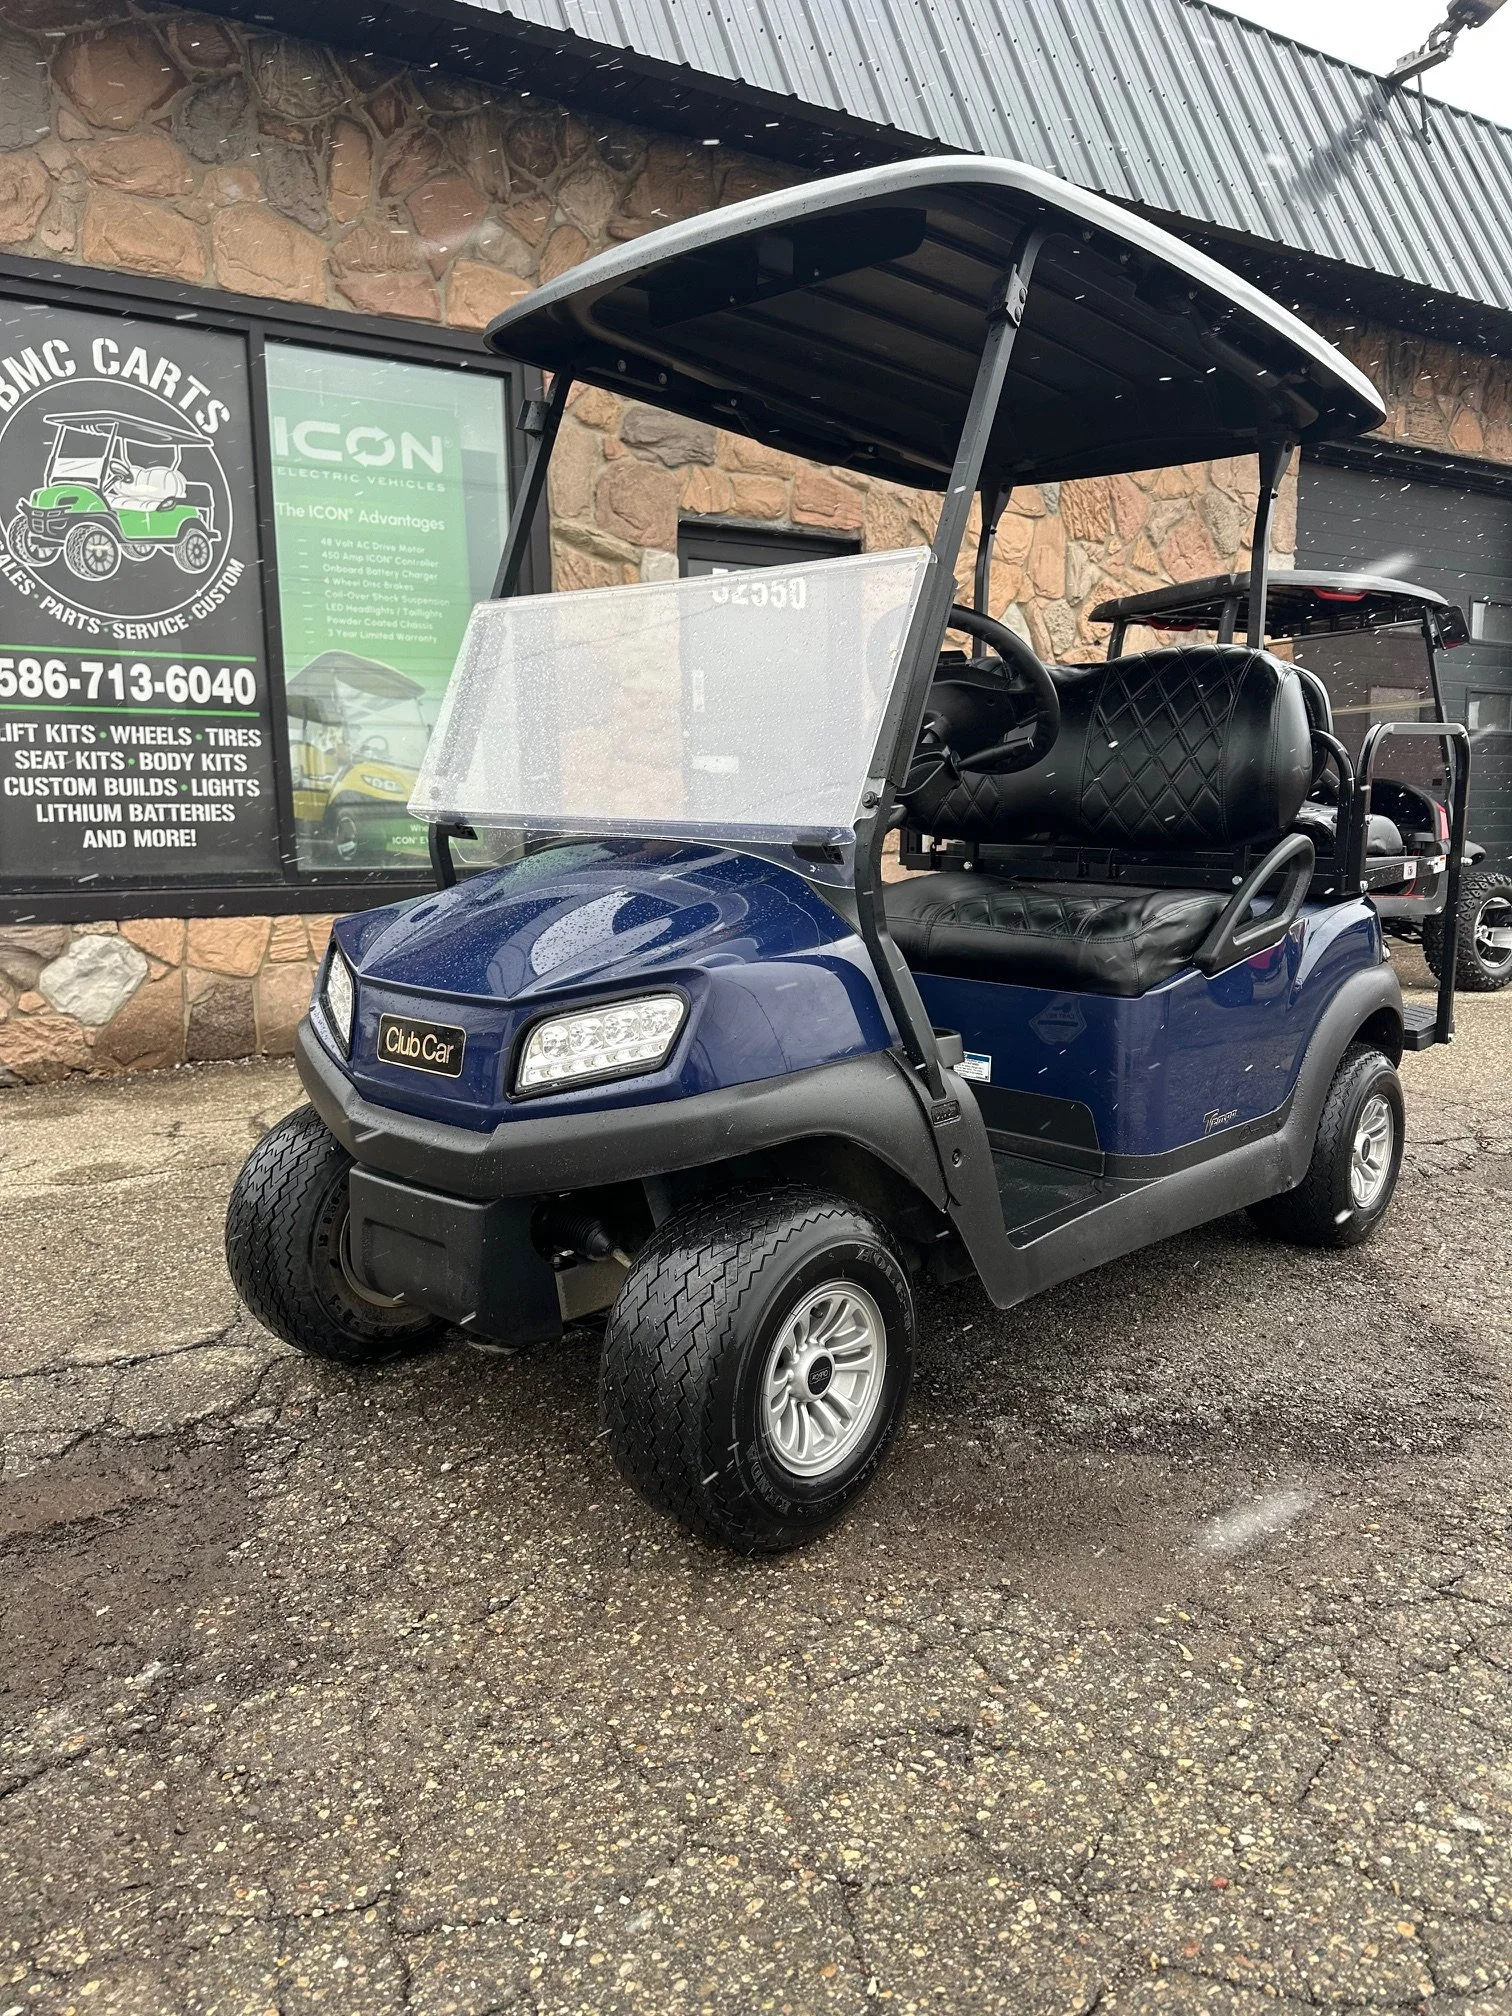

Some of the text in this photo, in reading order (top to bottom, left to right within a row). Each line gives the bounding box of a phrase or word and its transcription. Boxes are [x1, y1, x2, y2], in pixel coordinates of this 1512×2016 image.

[0, 338, 230, 434] BMC CARTS
[277, 467, 446, 492] ELECTRIC VEHICLES
[276, 502, 305, 518] The
[358, 510, 446, 532] Advantages
[335, 538, 354, 547] Volt
[357, 541, 370, 549] AC
[372, 542, 396, 551] Drive
[399, 545, 425, 553] Motor
[343, 552, 364, 562] Amp
[394, 557, 438, 567] Controller
[322, 564, 438, 581] Onboard Battery Charger
[0, 541, 245, 640] ALES PARTS SERVICE CUSTOM
[332, 578, 360, 587] Wheel
[363, 579, 381, 588] Disc
[384, 581, 414, 591] Brakes
[324, 590, 450, 607] Coil-Over Shock Suspension
[326, 603, 344, 612] LED
[346, 604, 395, 616] Headlights
[403, 608, 443, 619] Taillights
[327, 616, 433, 630] Powder Coated Chassis
[336, 629, 357, 637] Year
[360, 631, 394, 640] Limited
[396, 633, 437, 644] Warranty
[0, 657, 256, 705] 586-713-6040
[46, 724, 96, 744] KITS
[110, 725, 192, 746] WHEELS
[205, 728, 262, 748] TIRES
[15, 750, 248, 772] SEAT KITS BODY KITS
[4, 777, 260, 797] CUSTOM BUILDS LIGHTS
[36, 803, 235, 822] LITHIUM BATTERIES
[83, 829, 197, 848] AND MORE!
[386, 1027, 454, 1064] Club Car
